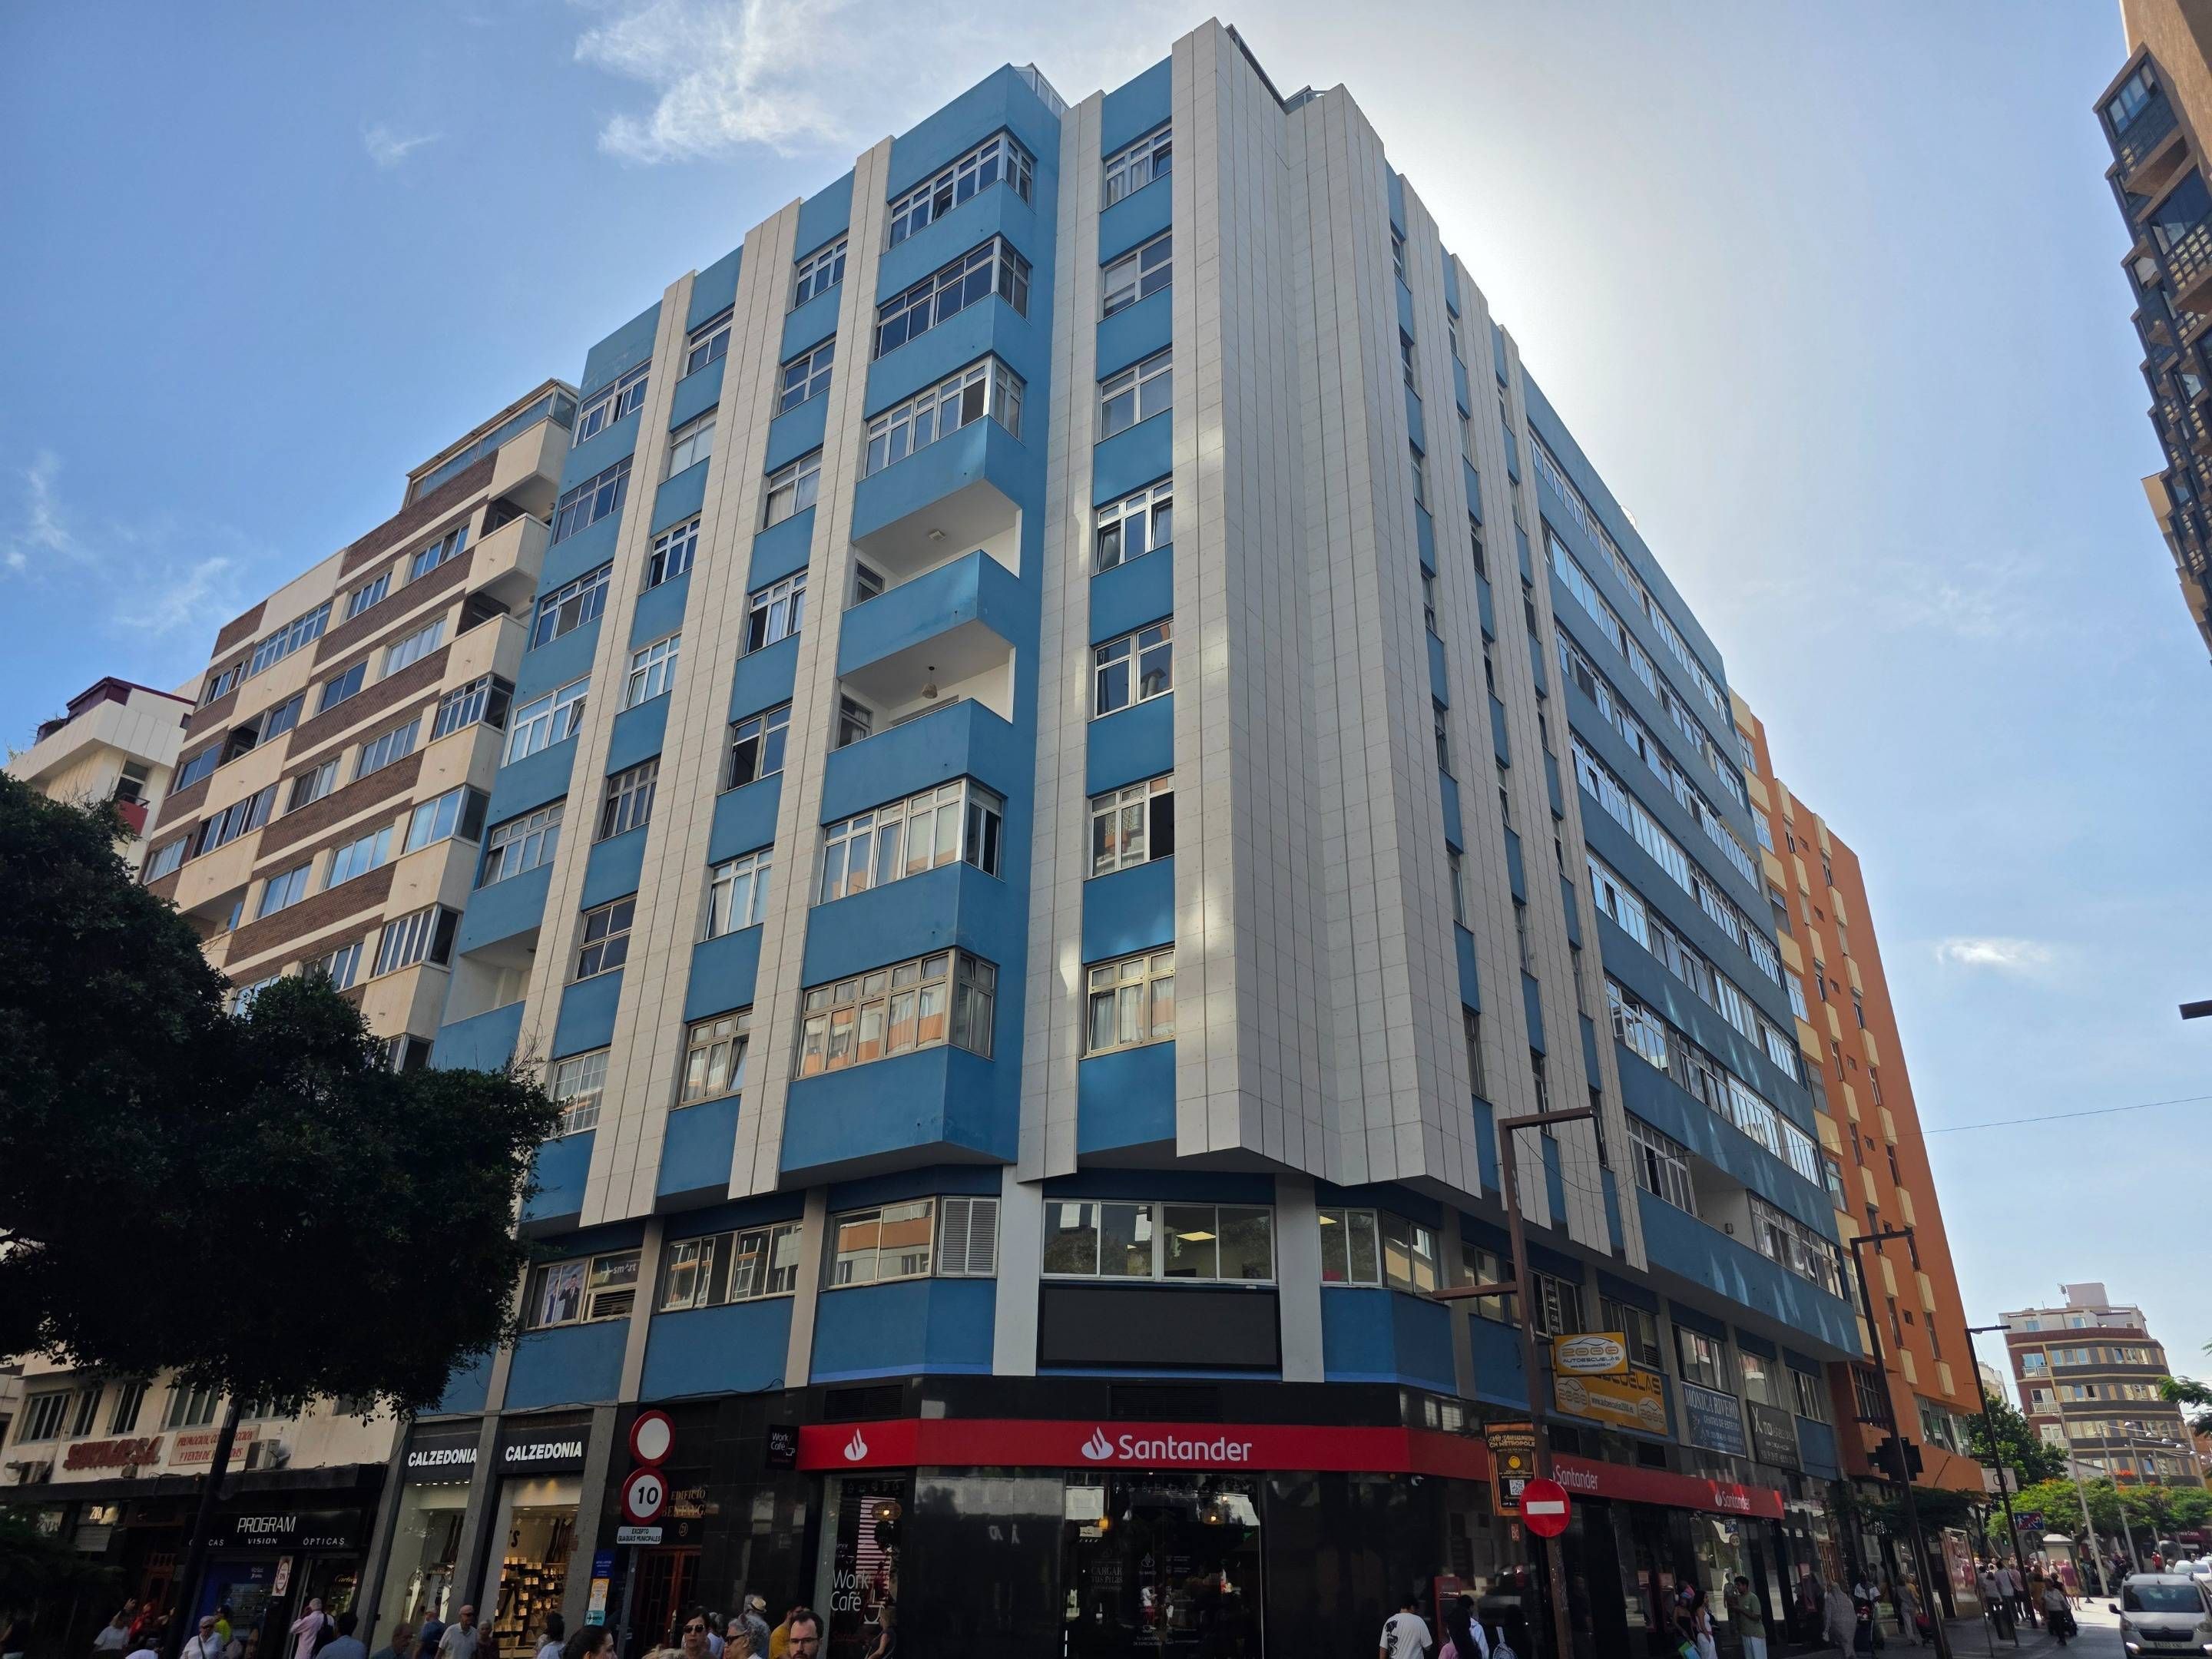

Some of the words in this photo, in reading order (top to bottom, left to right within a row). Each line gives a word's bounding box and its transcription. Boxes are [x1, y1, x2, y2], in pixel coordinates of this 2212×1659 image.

[1561, 1346, 1619, 1356] 2000
[1558, 1387, 1588, 1405] 2000
[1684, 1387, 1714, 1413] MÓNICA
[1713, 1396, 1738, 1420] RIVERO
[770, 1441, 786, 1451] Café
[772, 1432, 789, 1442] Work
[408, 1448, 477, 1466] CALZEDONIA
[505, 1441, 582, 1462] CALZEDONIA
[1118, 1435, 1253, 1461] Santander
[1555, 1464, 1598, 1491] Santander
[638, 1486, 659, 1505] 10
[671, 1488, 706, 1500] EDIFICIO
[1721, 1490, 1750, 1510] Santander
[237, 1515, 296, 1533] PROGRAM
[303, 1536, 346, 1546] ÓPTICAS
[833, 1569, 869, 1590] Work
[830, 1591, 862, 1611] Café
